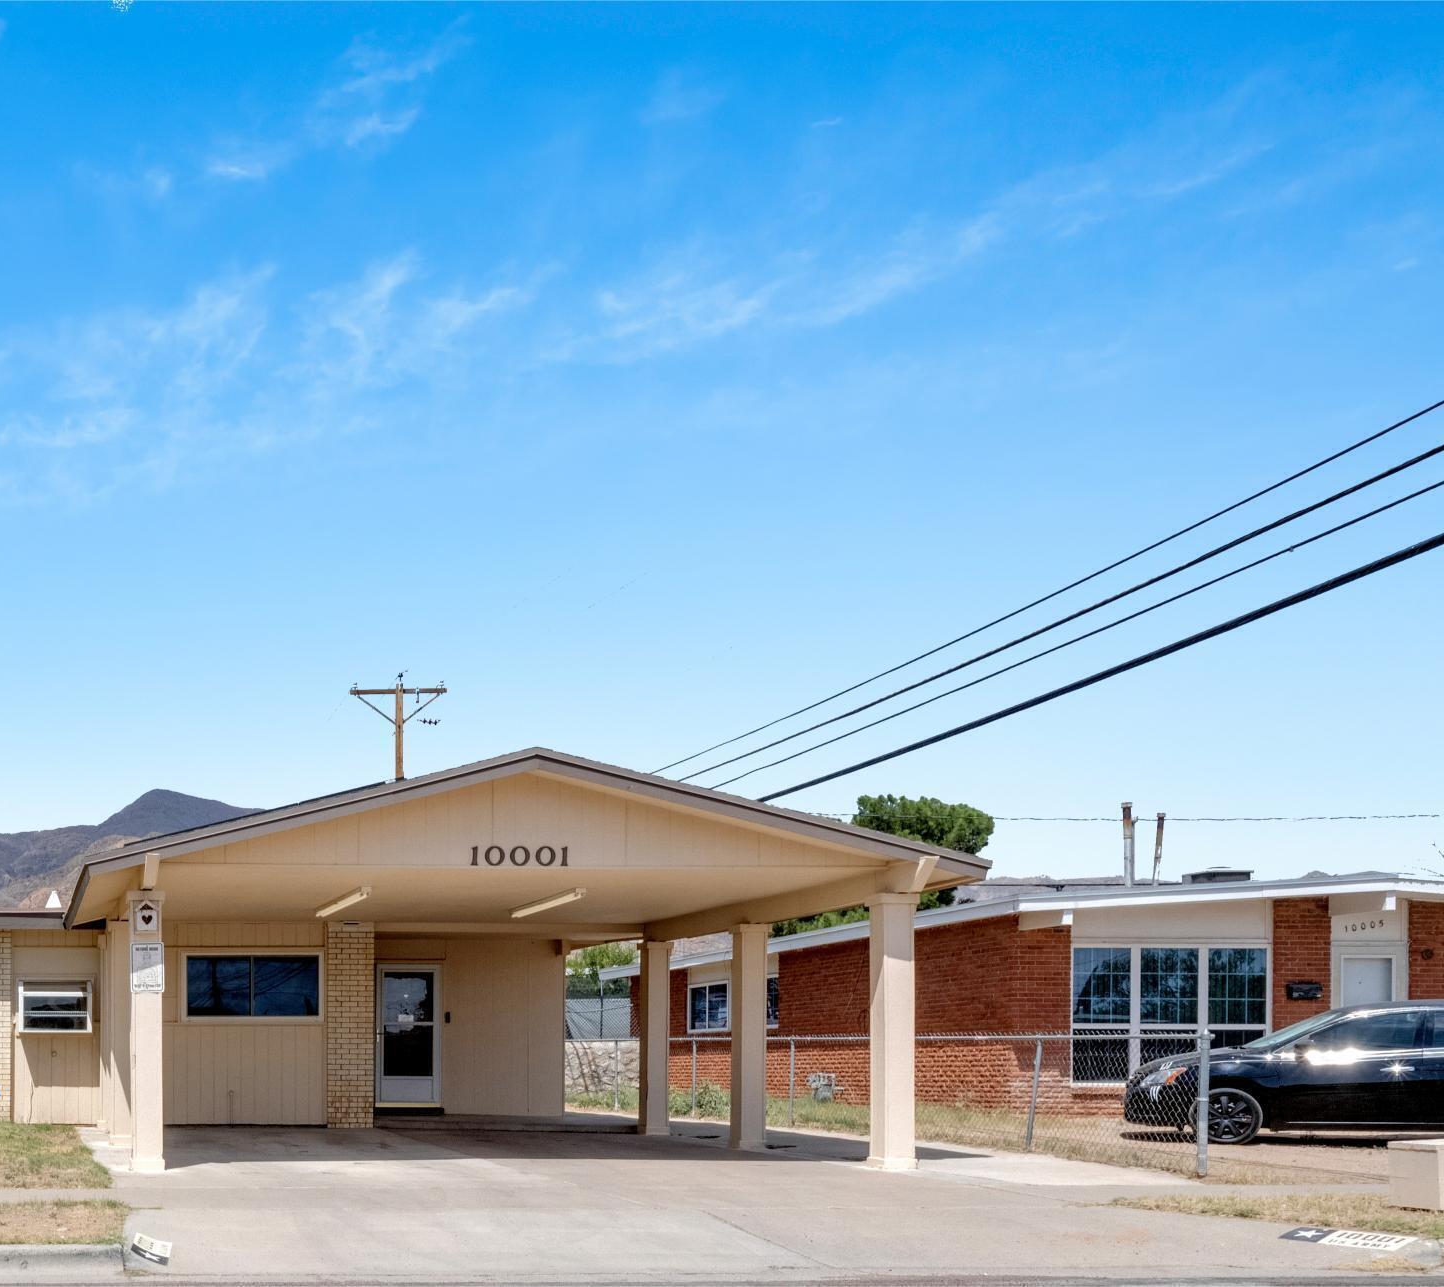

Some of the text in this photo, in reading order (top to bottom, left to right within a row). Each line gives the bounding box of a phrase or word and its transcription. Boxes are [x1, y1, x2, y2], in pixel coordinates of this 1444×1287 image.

[469, 845, 569, 867] 10001
[1344, 919, 1384, 933] 10005
[1335, 1231, 1407, 1244] 10001
[1352, 1240, 1391, 1249] ARMY
